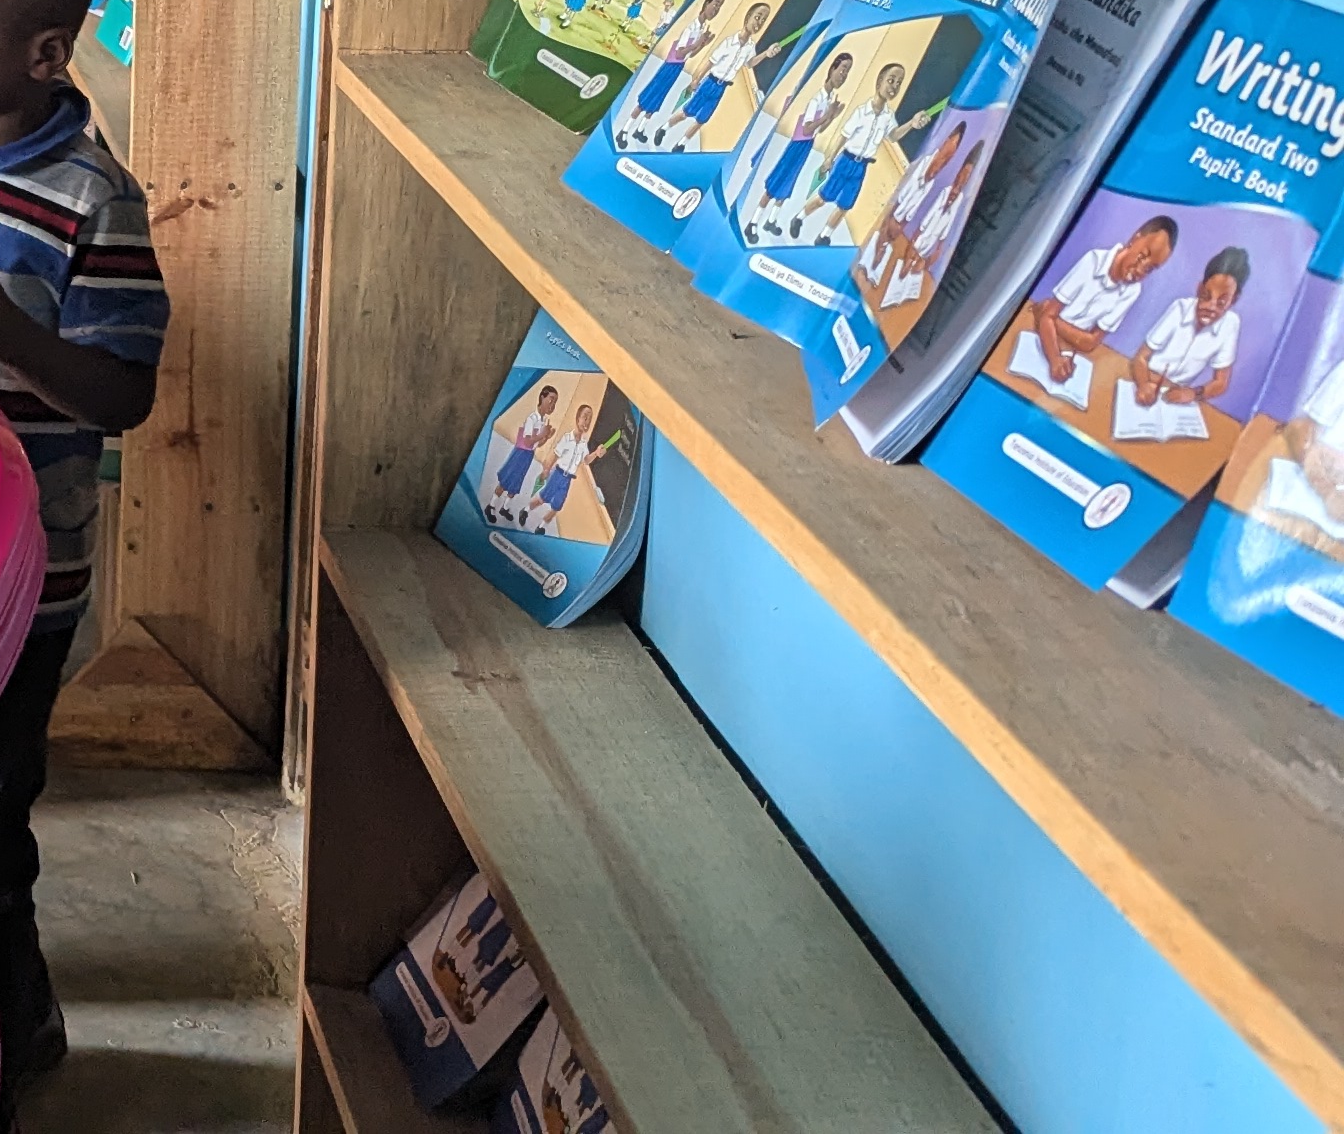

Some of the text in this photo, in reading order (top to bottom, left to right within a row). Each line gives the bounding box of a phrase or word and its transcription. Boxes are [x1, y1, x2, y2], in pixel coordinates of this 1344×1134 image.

[1195, 29, 1344, 158] Writing
[1189, 107, 1319, 177] Standard Two
[643, 172, 655, 186] Elimu
[1189, 146, 1288, 203] Pupil's Book
[758, 258, 803, 289] Taasisi ya Elimu
